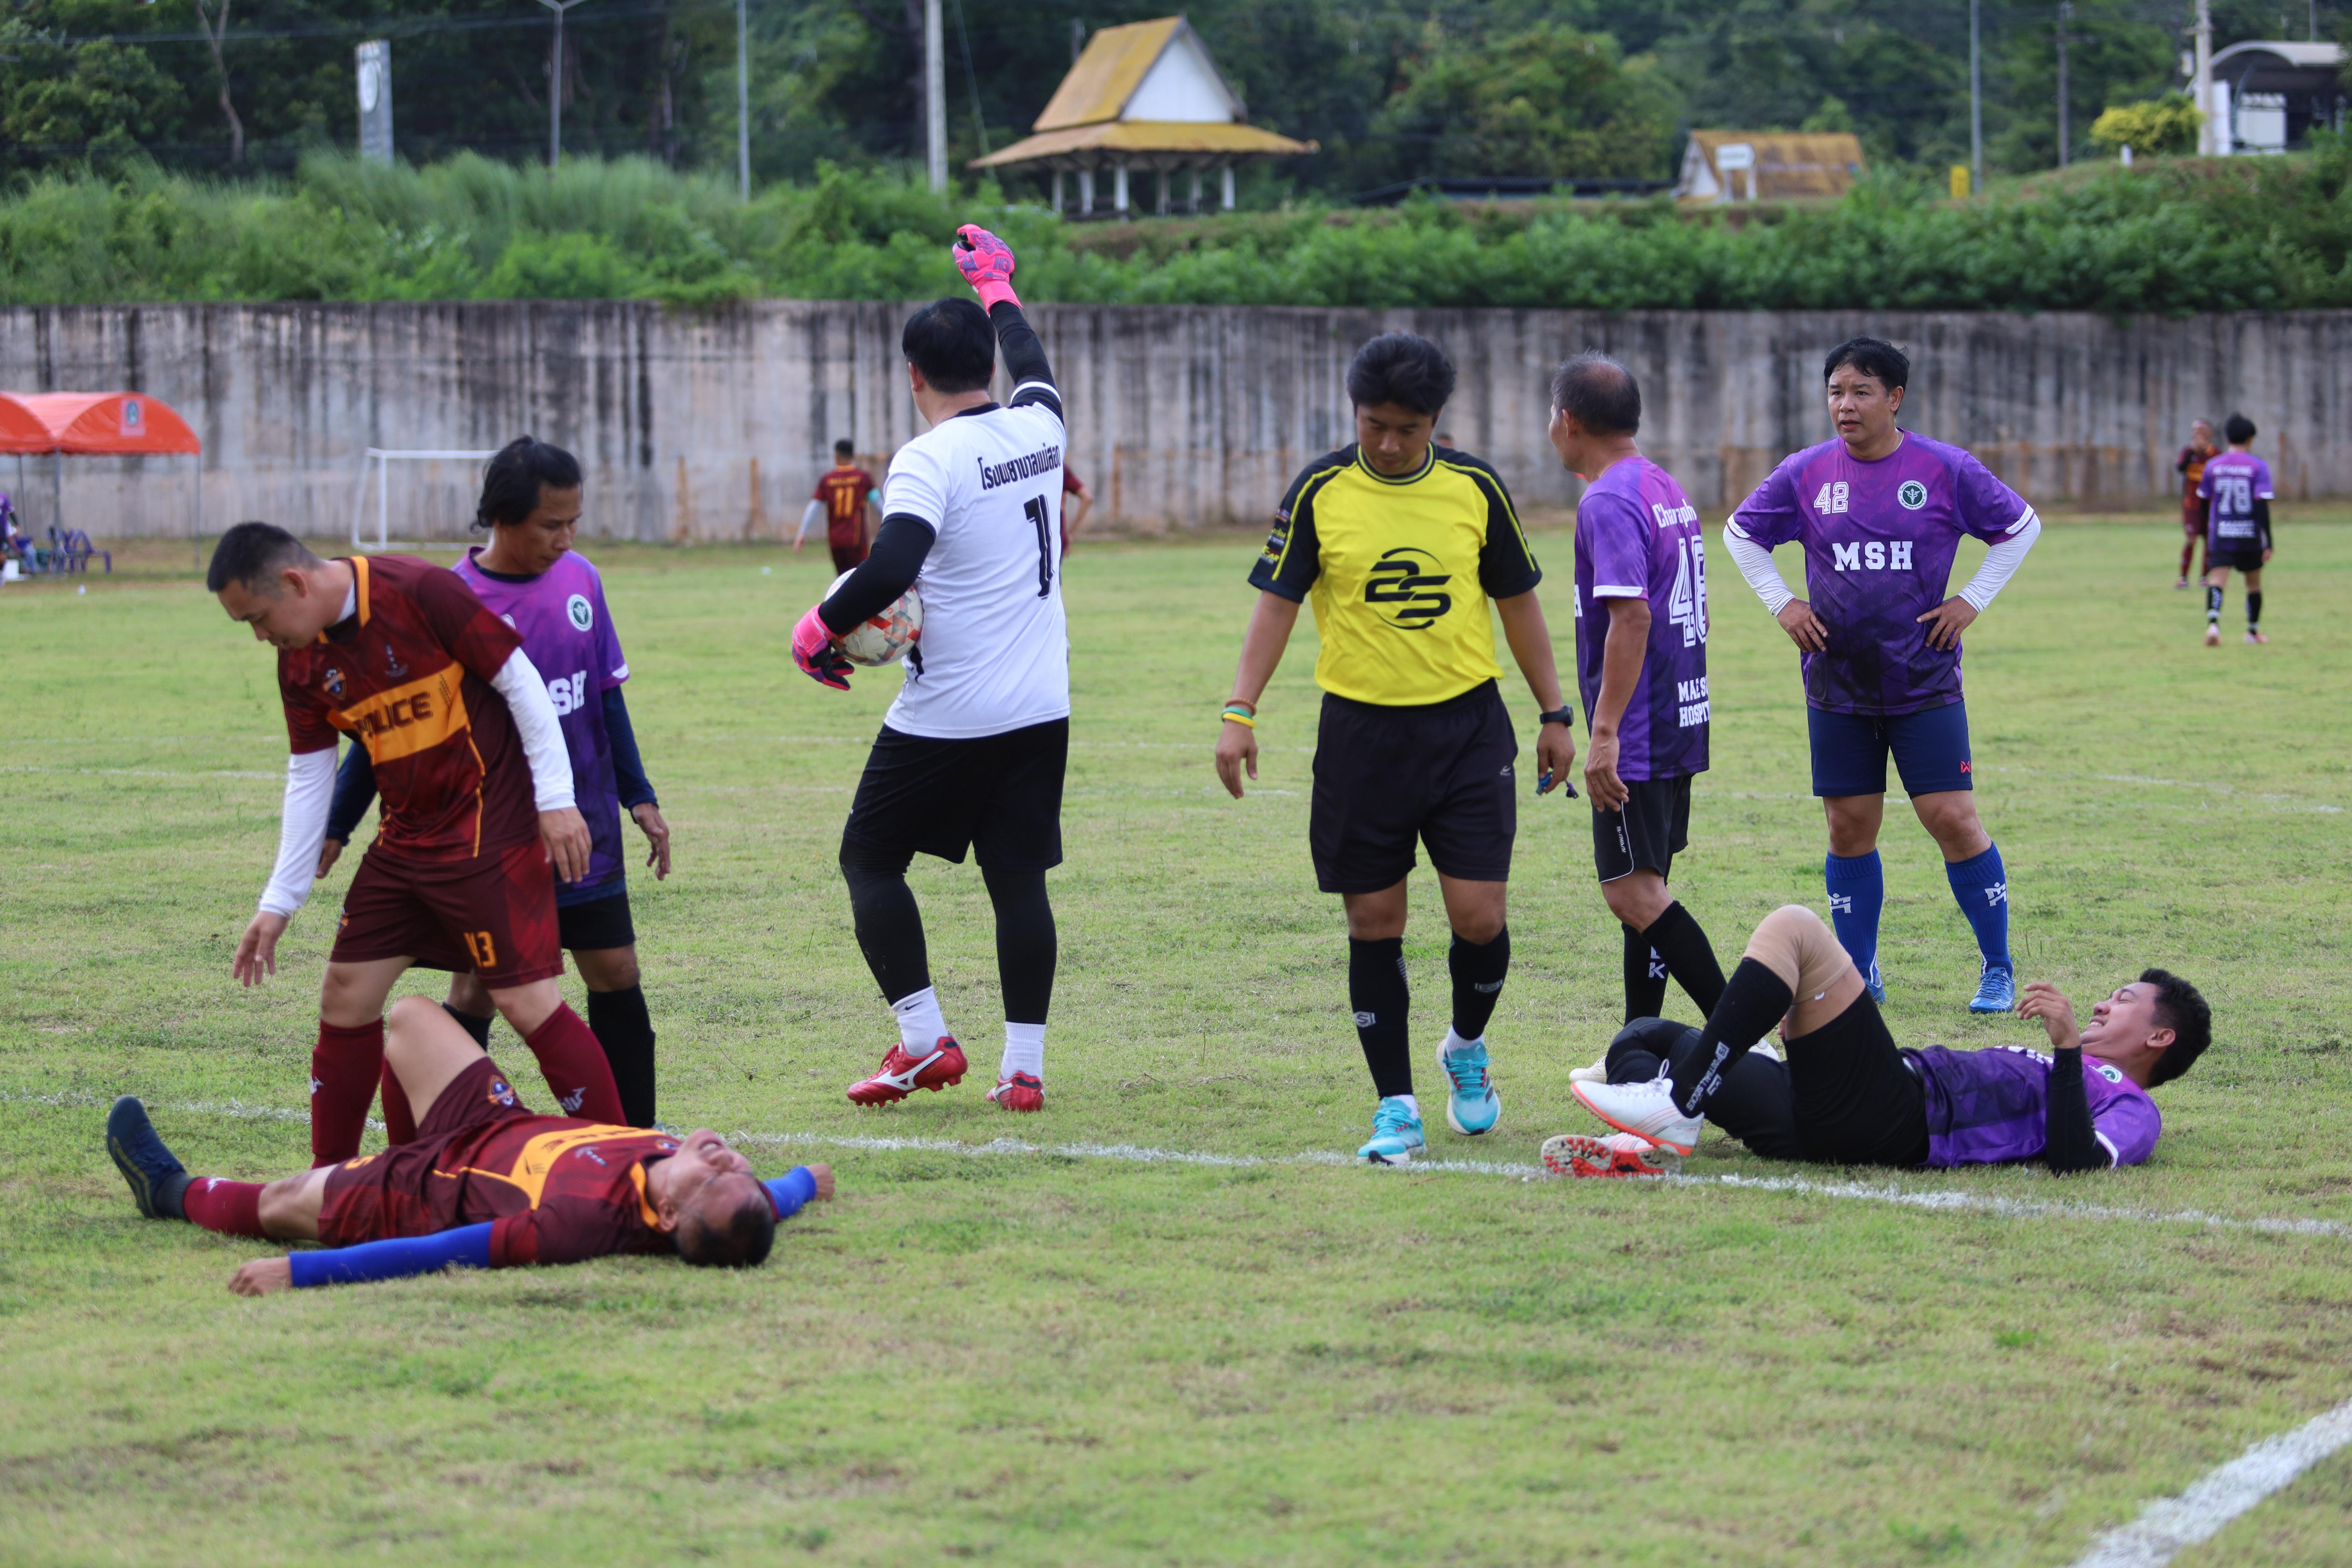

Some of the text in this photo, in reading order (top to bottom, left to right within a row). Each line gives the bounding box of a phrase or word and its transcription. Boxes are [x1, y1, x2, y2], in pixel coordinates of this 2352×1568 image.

[977, 442, 1061, 490] โรงพยาบาลแม่สอด
[835, 485, 855, 517] 11
[1814, 481, 1849, 514] 42
[1023, 494, 1055, 600] 1
[1832, 541, 1913, 571] MSH
[548, 670, 587, 716] SH
[1678, 675, 1708, 702] MAES
[1699, 1055, 1723, 1086] FOOTBALL
[1686, 1084, 1704, 1111] SOCKS
